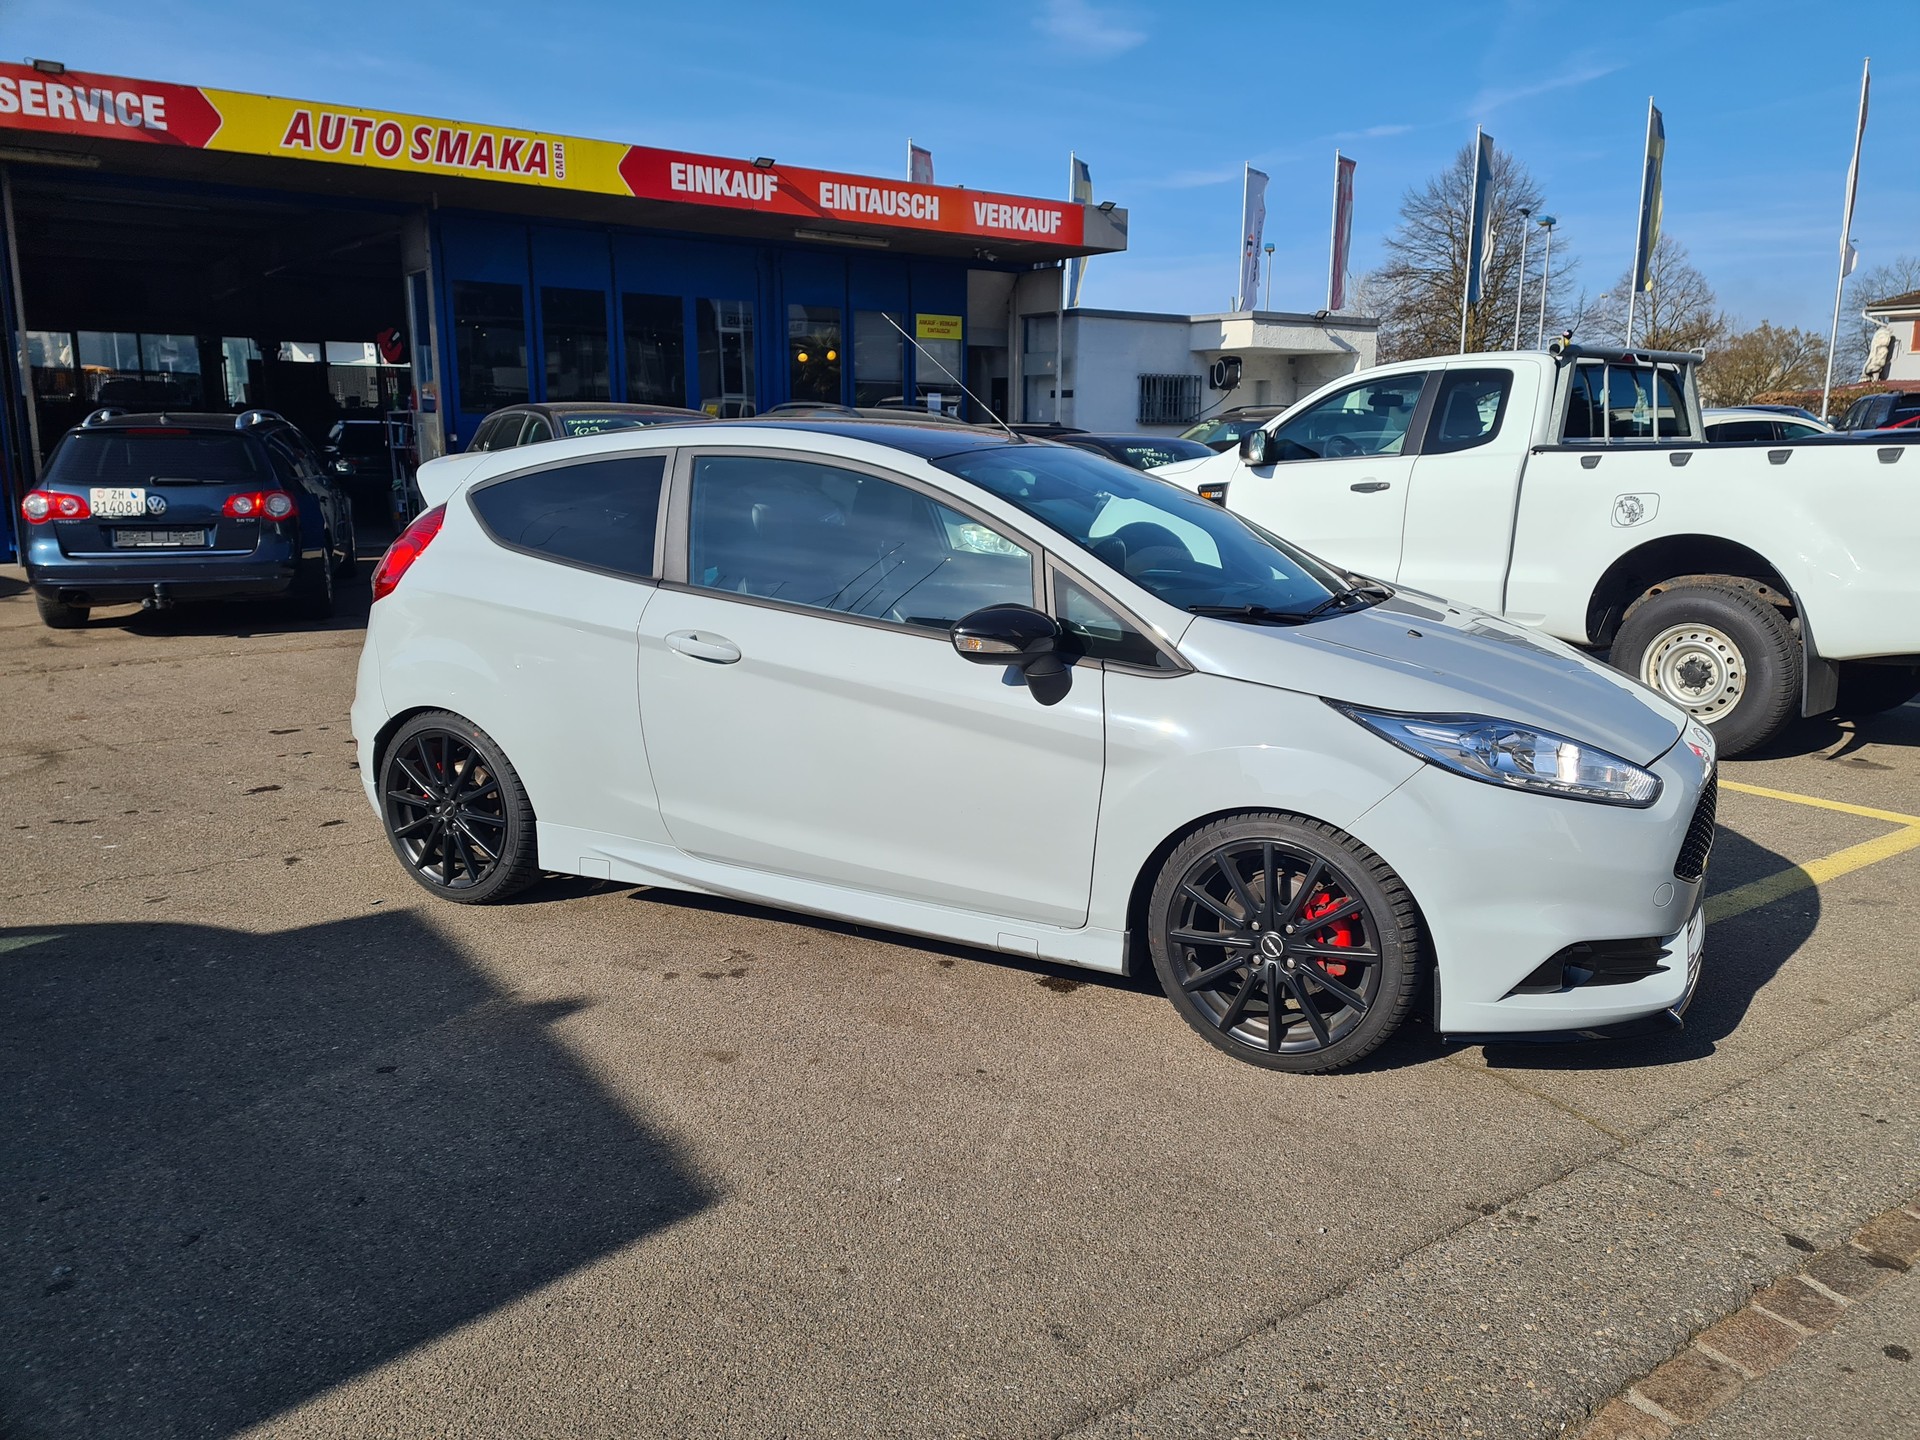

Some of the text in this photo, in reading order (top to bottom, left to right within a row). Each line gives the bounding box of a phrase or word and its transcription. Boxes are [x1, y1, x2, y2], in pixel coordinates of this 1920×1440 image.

[0, 76, 167, 131] SERVICE
[280, 109, 549, 177] AUTO SMAKA
[554, 142, 565, 178] GMBH
[670, 162, 778, 201] EINKAUF
[819, 181, 939, 221] EINTAUSCH
[973, 201, 1062, 234] VERKAUF
[111, 490, 125, 500] ZH
